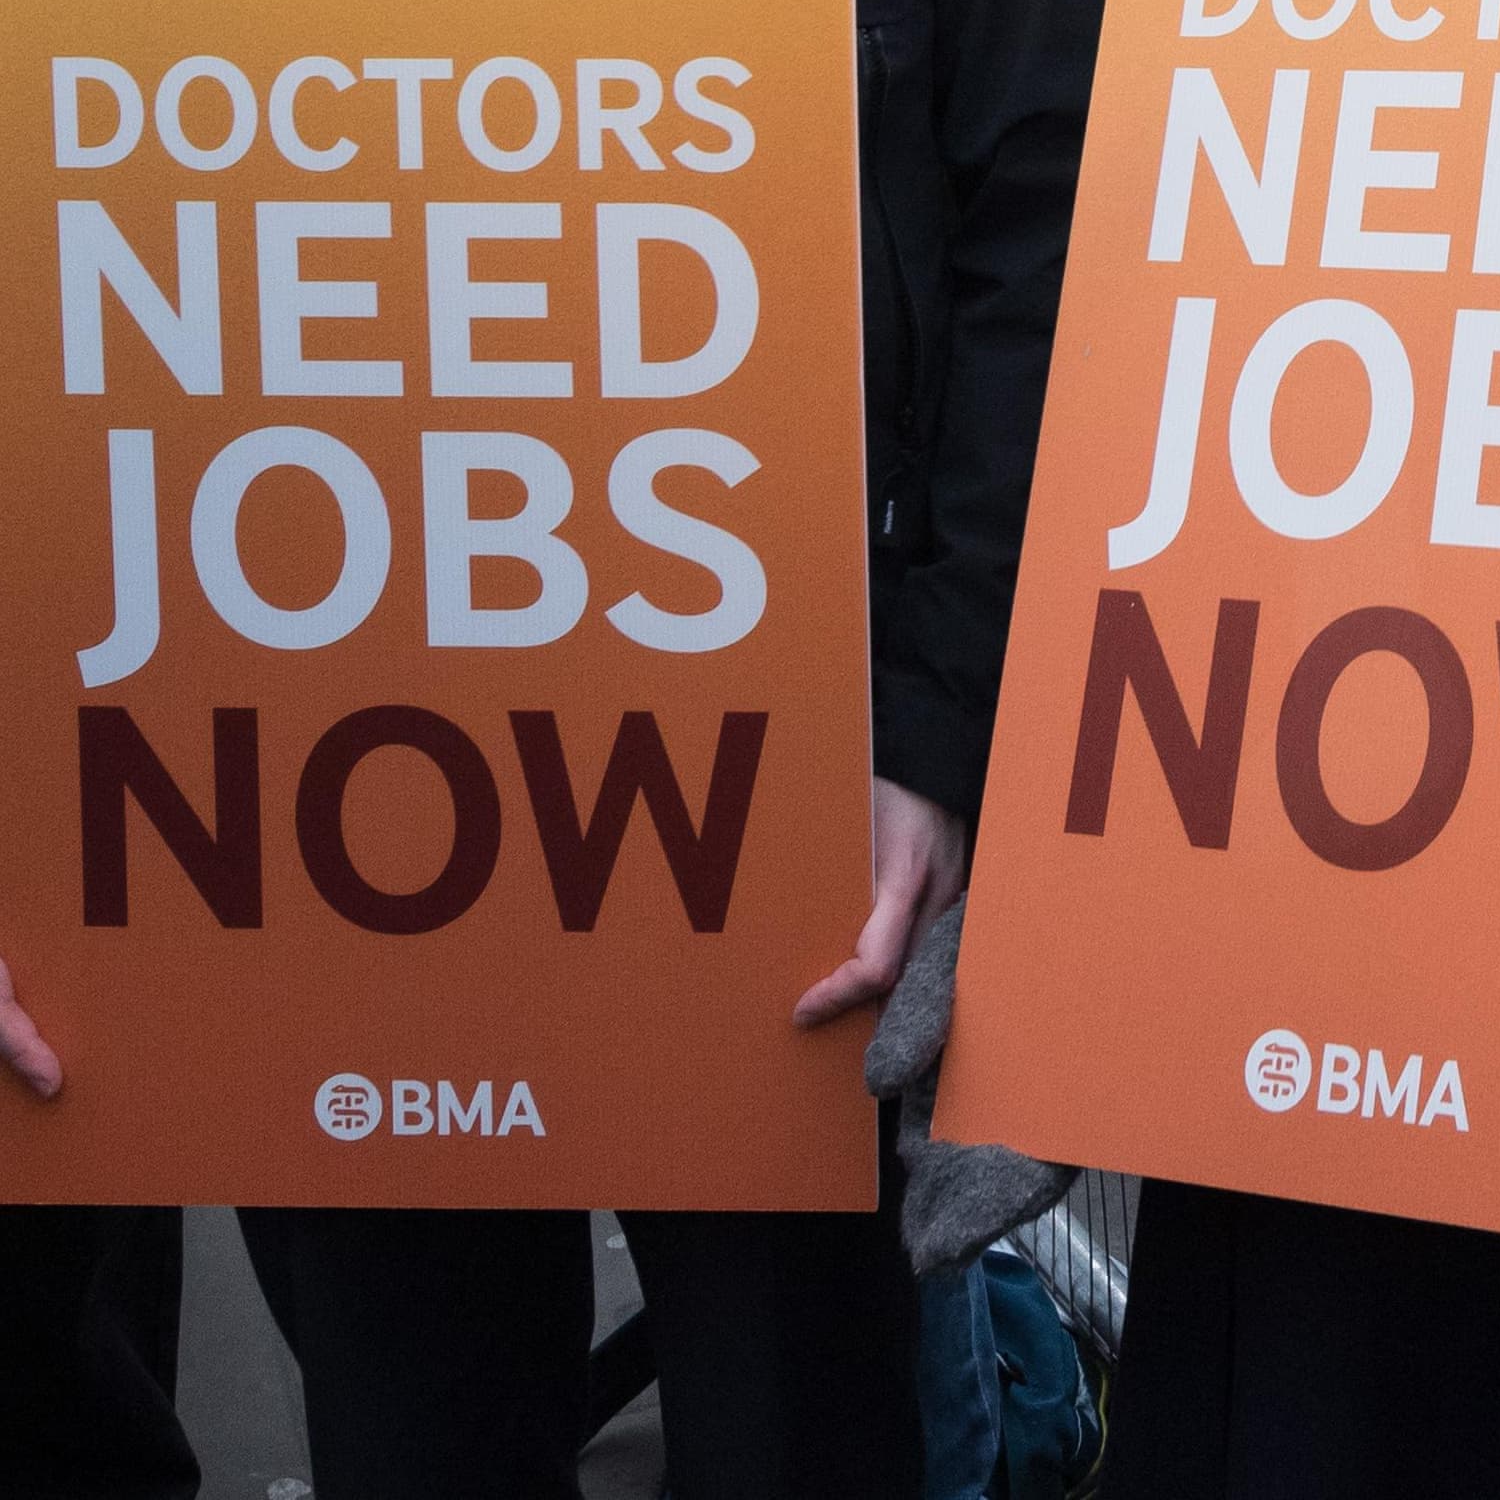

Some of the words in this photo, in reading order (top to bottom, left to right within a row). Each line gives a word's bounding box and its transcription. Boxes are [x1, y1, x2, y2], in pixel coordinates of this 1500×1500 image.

[51, 55, 757, 173] DOCTORS
[57, 200, 760, 399] NEED
[76, 426, 768, 689] JOBS
[77, 704, 770, 936] NOW
[391, 1079, 546, 1137] BMA
[1316, 1042, 1470, 1132] BMA
